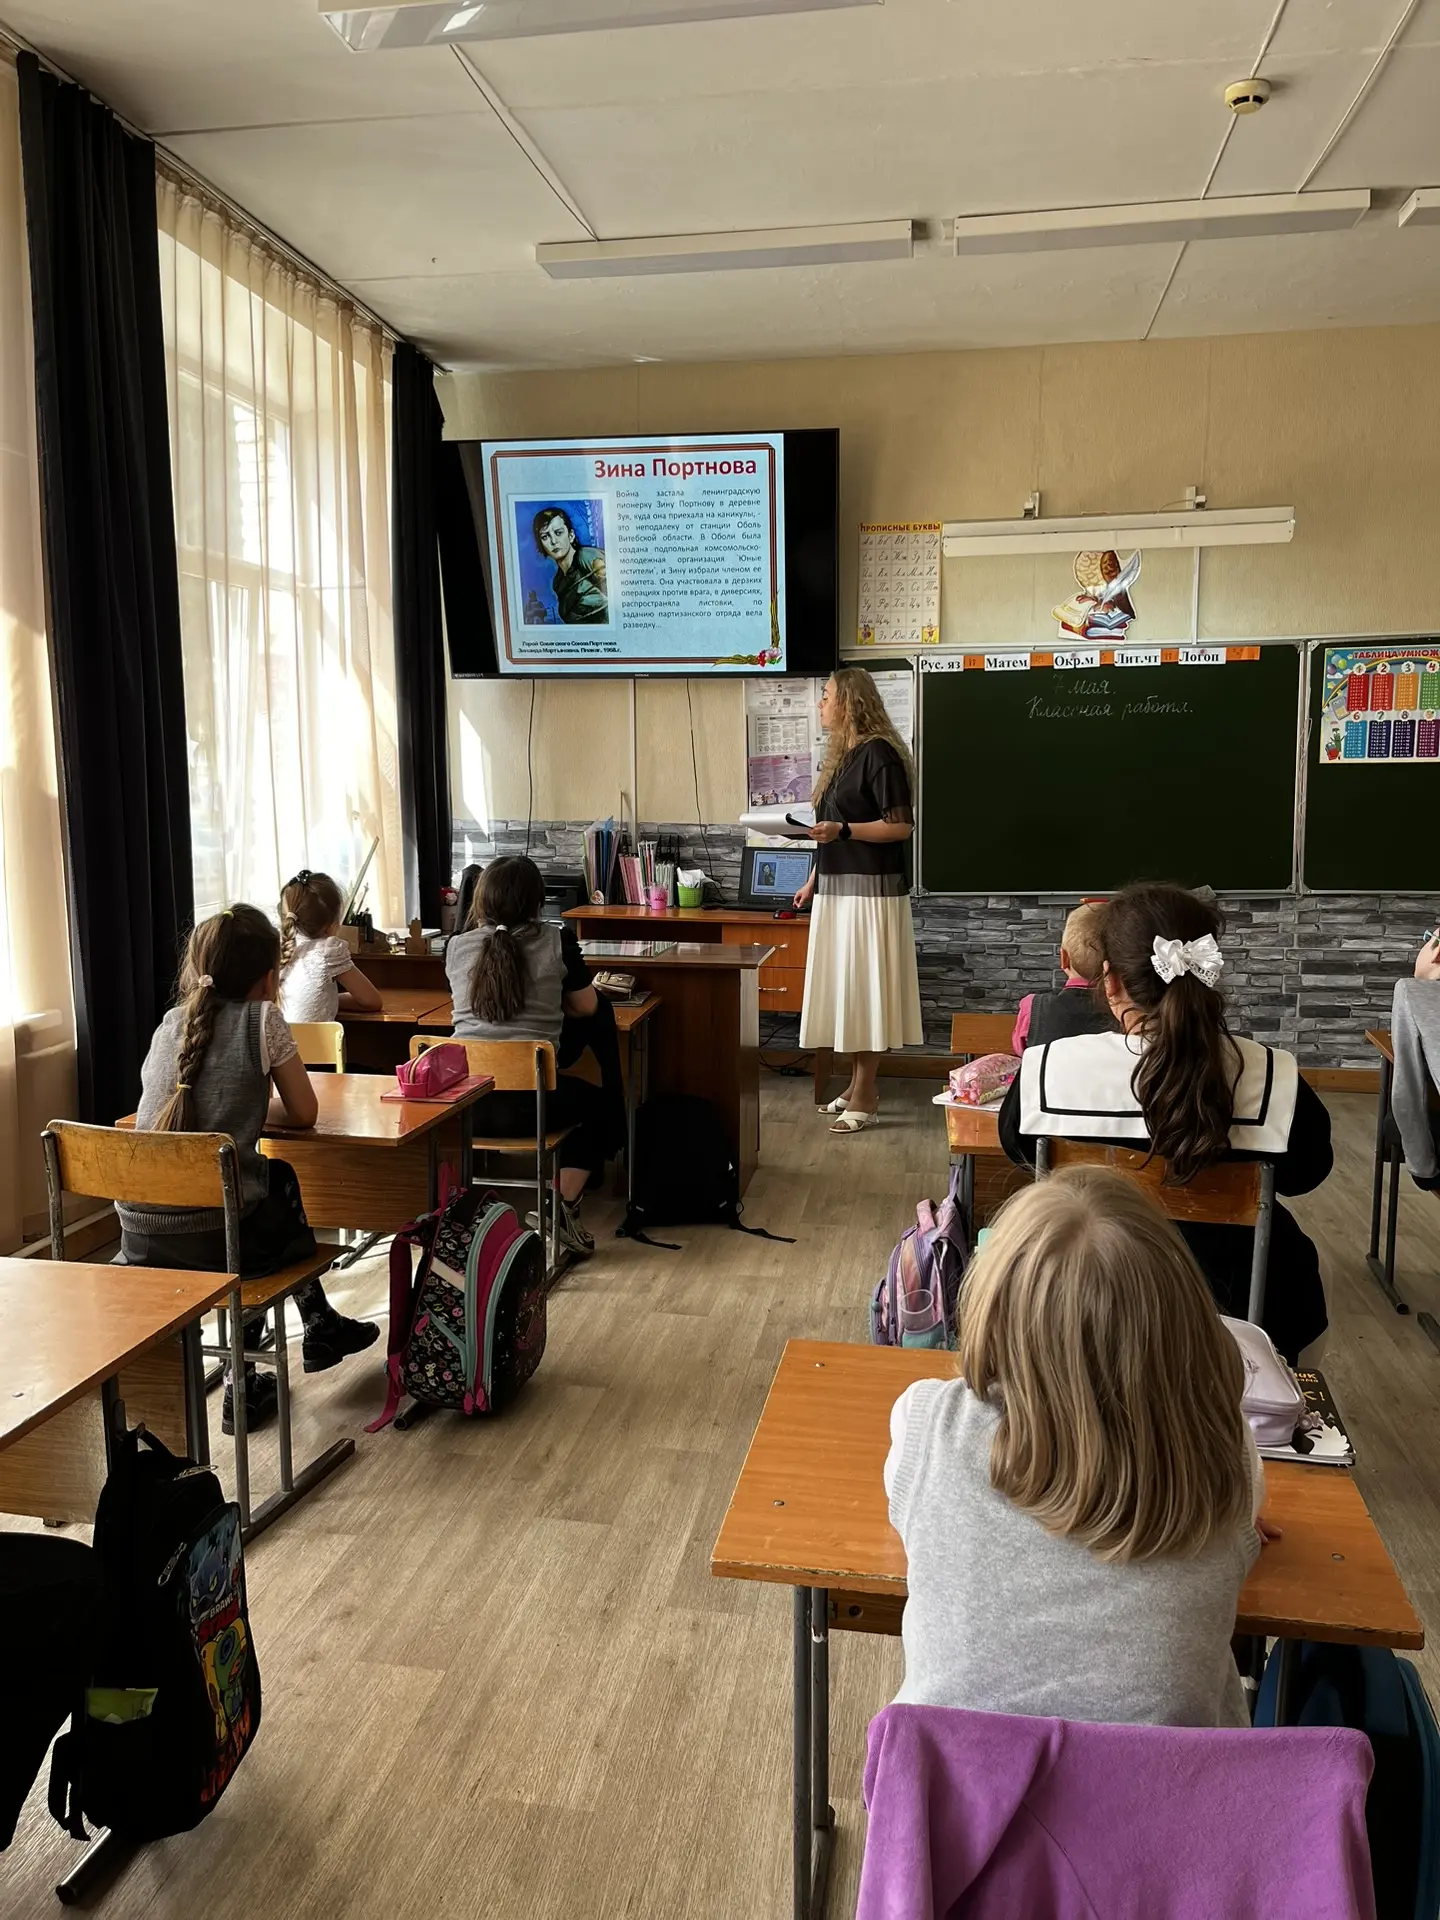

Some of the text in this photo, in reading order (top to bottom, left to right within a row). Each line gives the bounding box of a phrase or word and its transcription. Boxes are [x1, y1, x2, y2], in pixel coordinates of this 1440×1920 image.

[595, 457, 756, 480] Зина Портнова
[616, 490, 639, 498] Война
[701, 488, 760, 497] ленинградскую
[617, 502, 652, 511] пионерку
[657, 500, 674, 510] Зину
[679, 499, 715, 509] Портнову
[728, 499, 760, 508] деревне
[618, 513, 631, 522] Зуя,
[634, 513, 650, 522] куда
[668, 512, 703, 521] приехала
[717, 511, 755, 520] каникулы,
[636, 524, 679, 532] неподалеку
[700, 523, 730, 531] станции
[736, 521, 761, 529] Оболь
[860, 523, 940, 532] ПРОПИСНЫЕ БУКВЫ
[618, 532, 761, 543] Витебской области. В Оболи была
[619, 544, 760, 555] создана подпольная комсомольско-
[677, 556, 724, 565] организация
[669, 566, 686, 576] Зину
[688, 566, 719, 575] избрали
[659, 577, 673, 586] Она
[677, 578, 721, 587] участвовала
[731, 578, 762, 586] дерзких
[621, 590, 660, 598] операциях
[662, 590, 687, 598] против
[690, 589, 712, 597] врага,
[720, 588, 762, 597] диверсиях,
[622, 600, 679, 609] распространяла
[698, 600, 733, 608] листовки,
[623, 611, 654, 620] заданию
[658, 611, 711, 619] партизанского
[715, 611, 741, 619] отряда
[1114, 653, 1160, 664] Лит.чт
[1179, 651, 1219, 663] Логоп
[1353, 651, 1398, 659] ТАБЛИЦА
[920, 660, 961, 672] Рус. яз
[986, 657, 1028, 669] Матем
[1054, 655, 1094, 669] Окр.м
[1404, 664, 1411, 672] 3
[1429, 663, 1436, 672] 4
[1068, 680, 1116, 695] мая.
[1025, 695, 1193, 720] Классная работа.
[1401, 711, 1408, 719] 8
